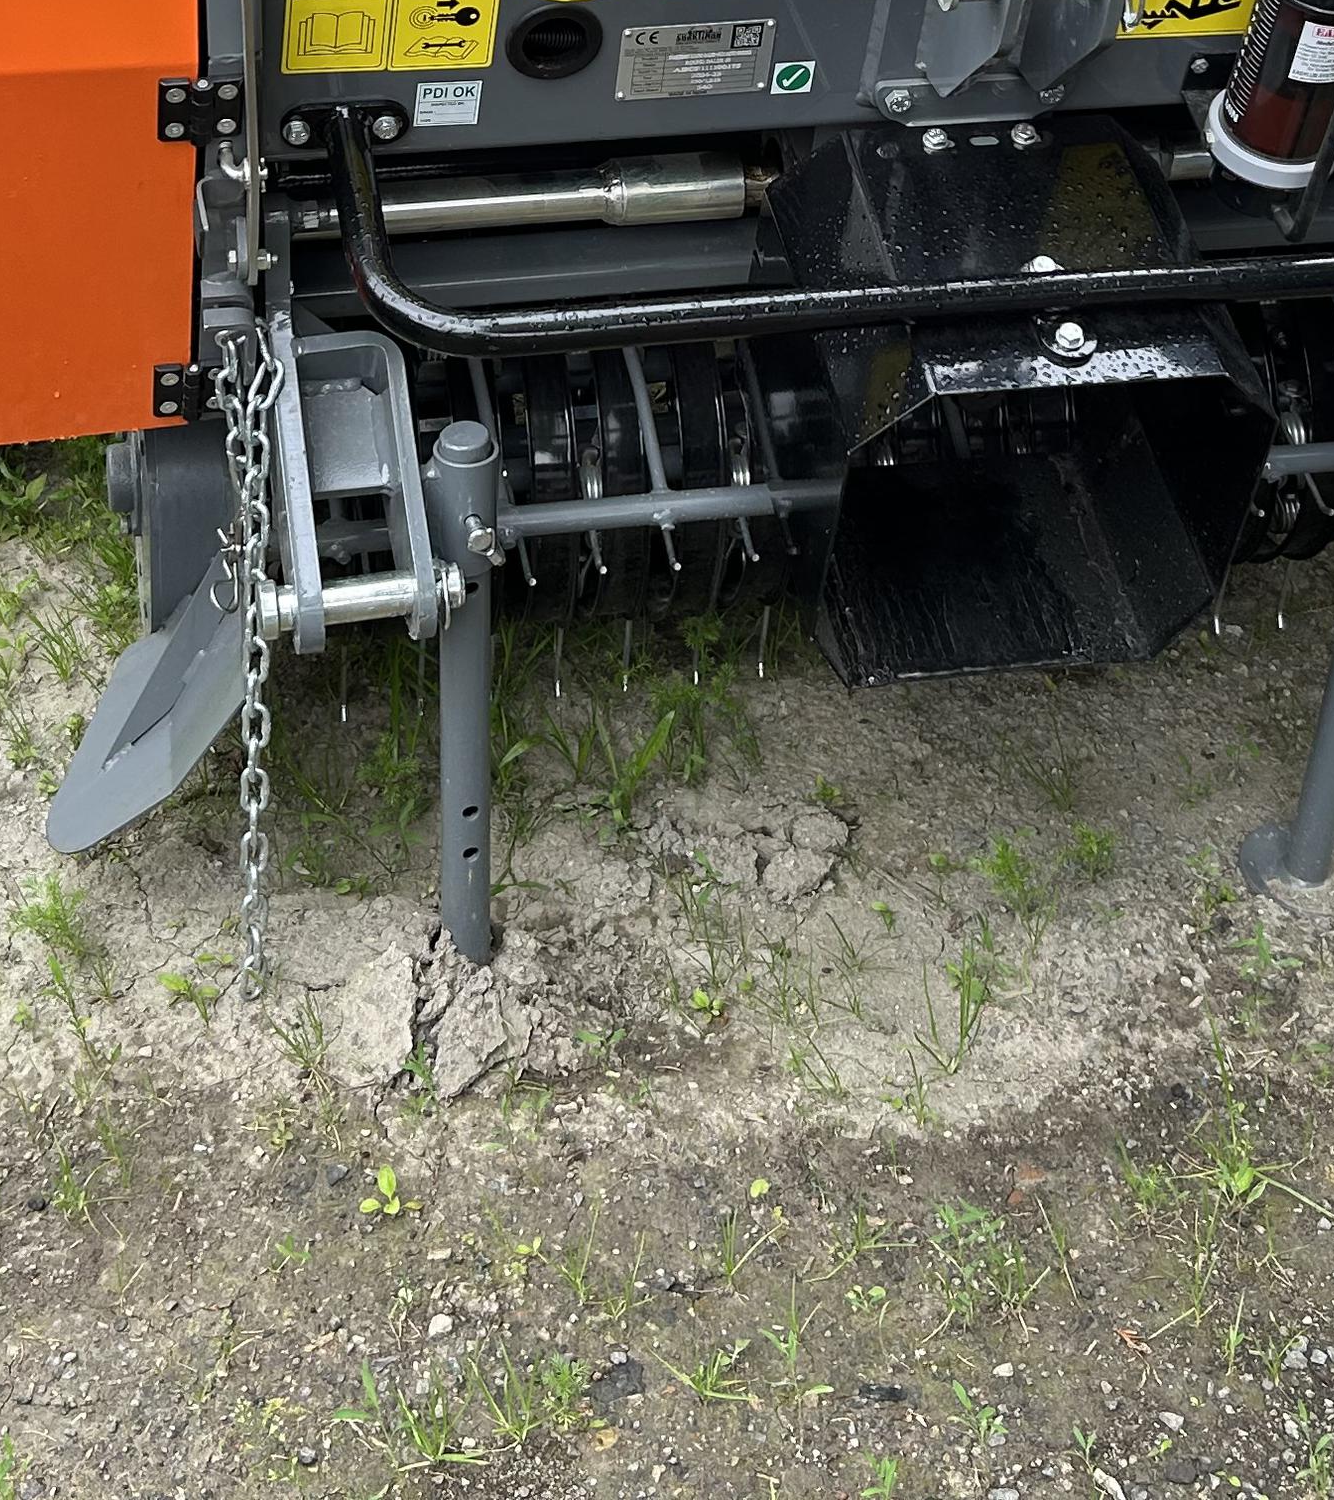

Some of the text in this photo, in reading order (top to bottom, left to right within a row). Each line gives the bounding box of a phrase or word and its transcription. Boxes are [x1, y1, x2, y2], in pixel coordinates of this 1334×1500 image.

[635, 31, 660, 46] CE
[423, 86, 476, 99] PDI OK
